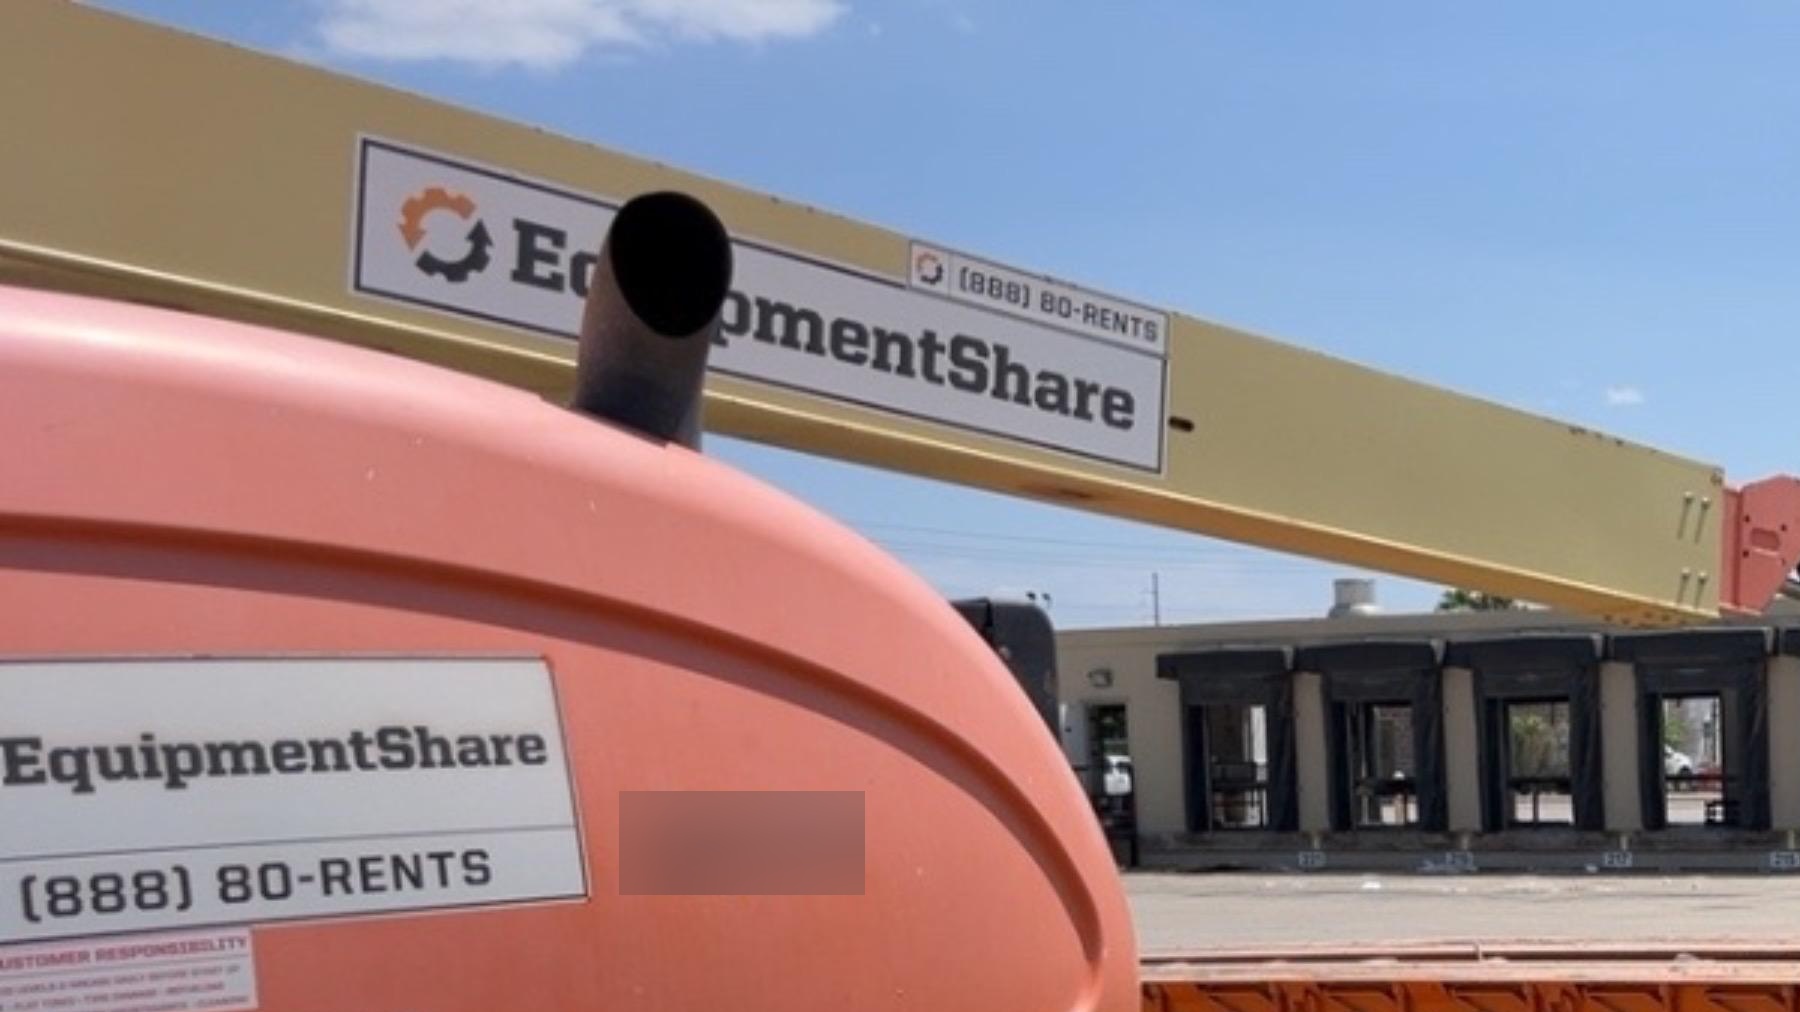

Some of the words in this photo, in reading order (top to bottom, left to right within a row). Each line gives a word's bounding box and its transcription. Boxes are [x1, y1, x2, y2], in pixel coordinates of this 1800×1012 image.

[959, 266, 1031, 309] (888)
[1039, 290, 1158, 343] 80-RENTS
[0, 725, 548, 795] EquipmentShare
[20, 864, 193, 924] (888)
[216, 849, 492, 904] 80-RENTS
[0, 950, 90, 969] USTOMER
